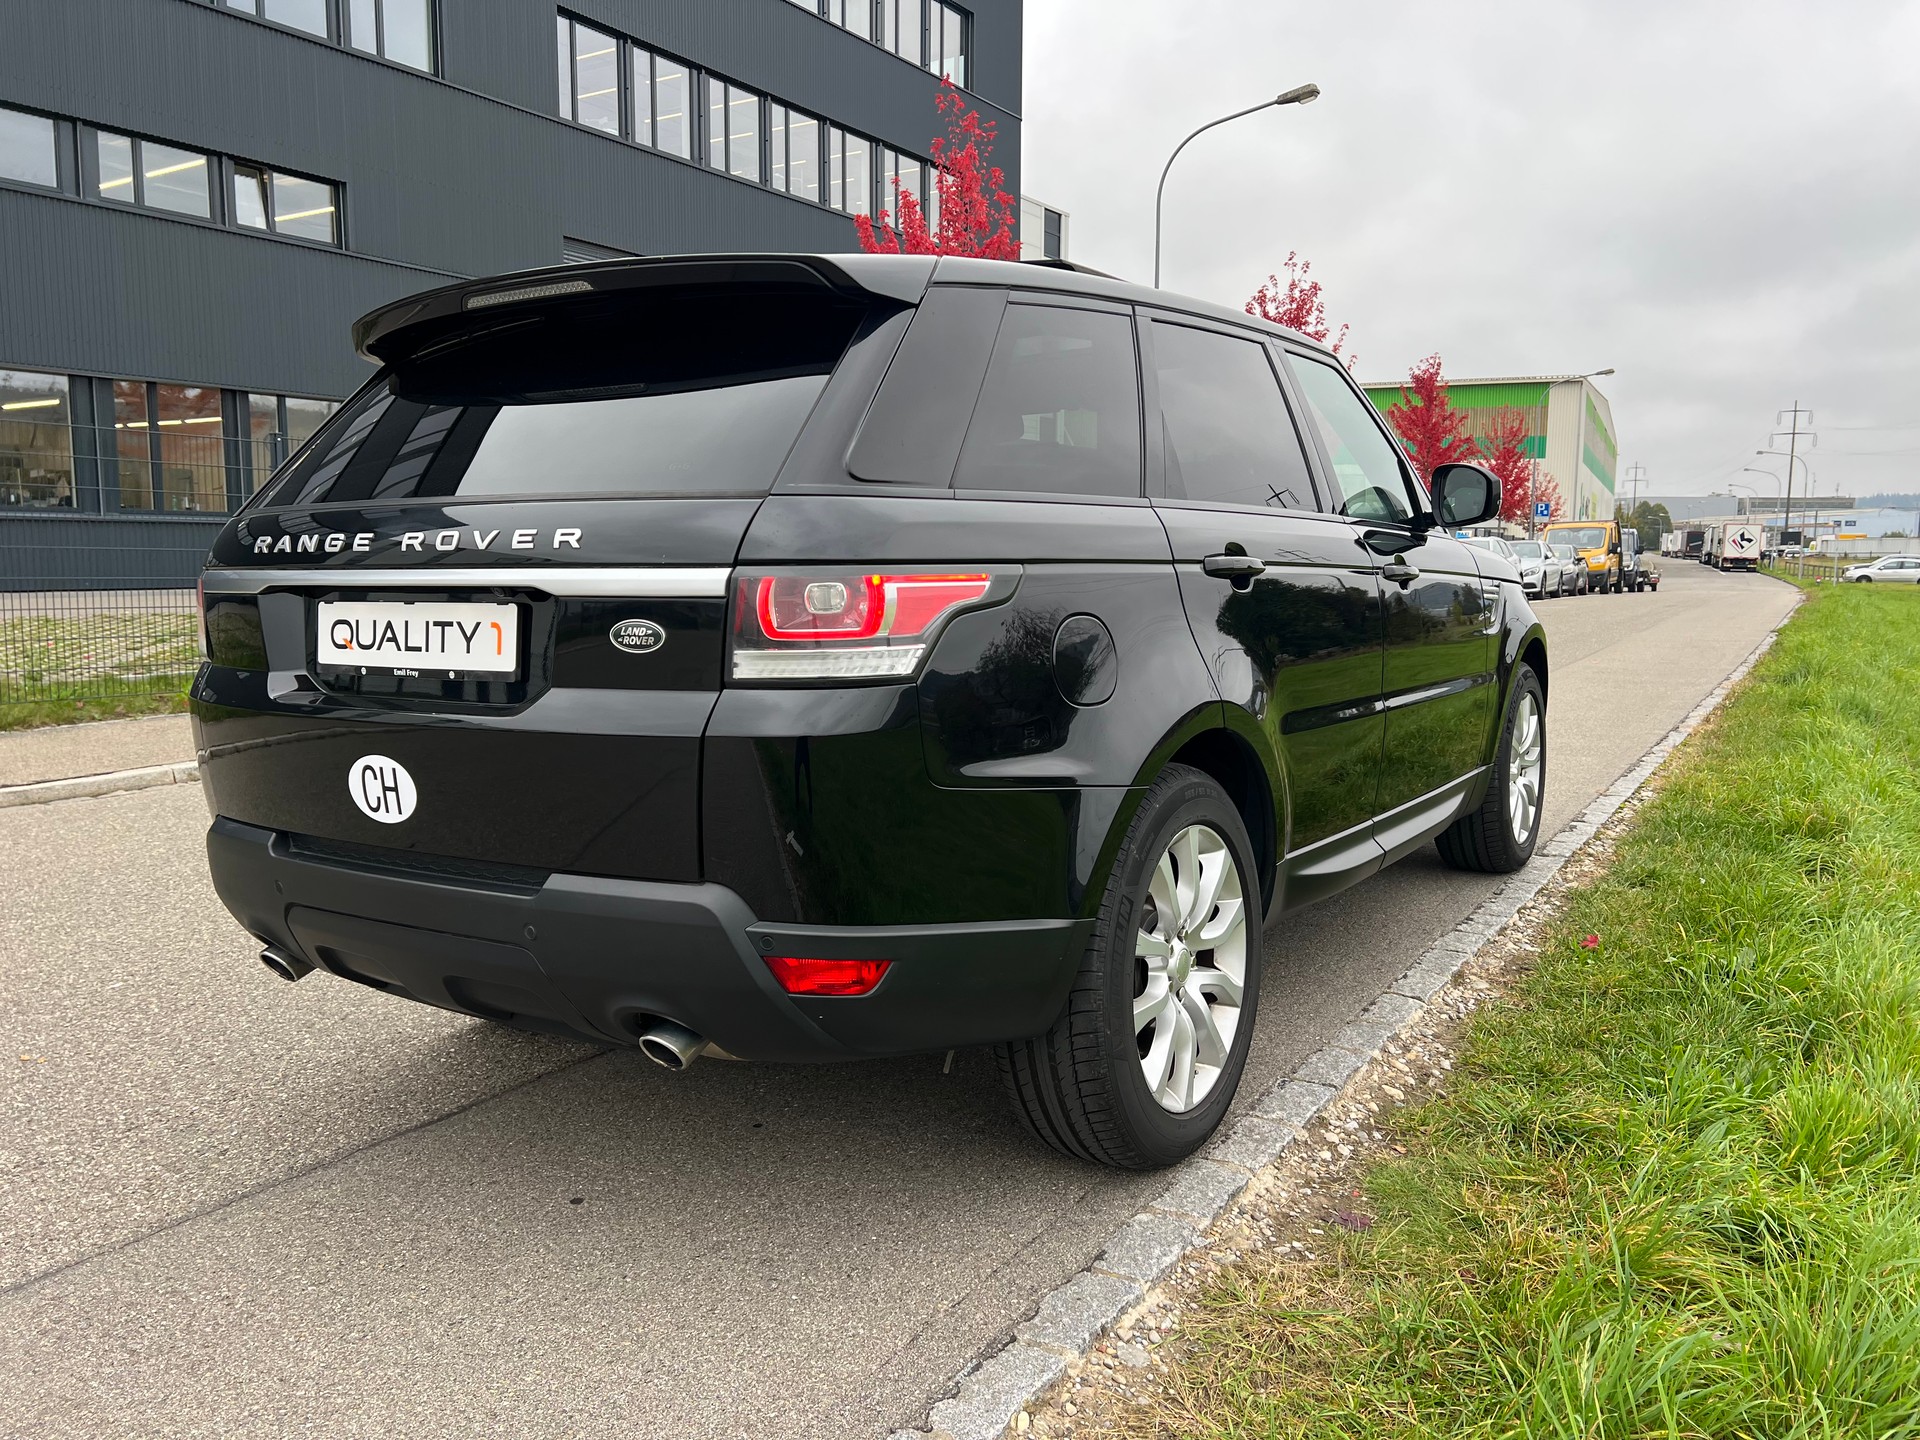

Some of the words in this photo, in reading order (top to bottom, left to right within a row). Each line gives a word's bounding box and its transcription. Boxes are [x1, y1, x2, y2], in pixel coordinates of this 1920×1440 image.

[1537, 503, 1546, 514] P
[253, 532, 376, 554] RANGE
[400, 527, 583, 552] ROVER
[330, 618, 482, 655] QUALITY
[620, 626, 647, 636] LAND
[622, 635, 655, 646] ROVER
[393, 668, 406, 676] Emil
[406, 669, 419, 678] Frey
[361, 764, 403, 815] CH
